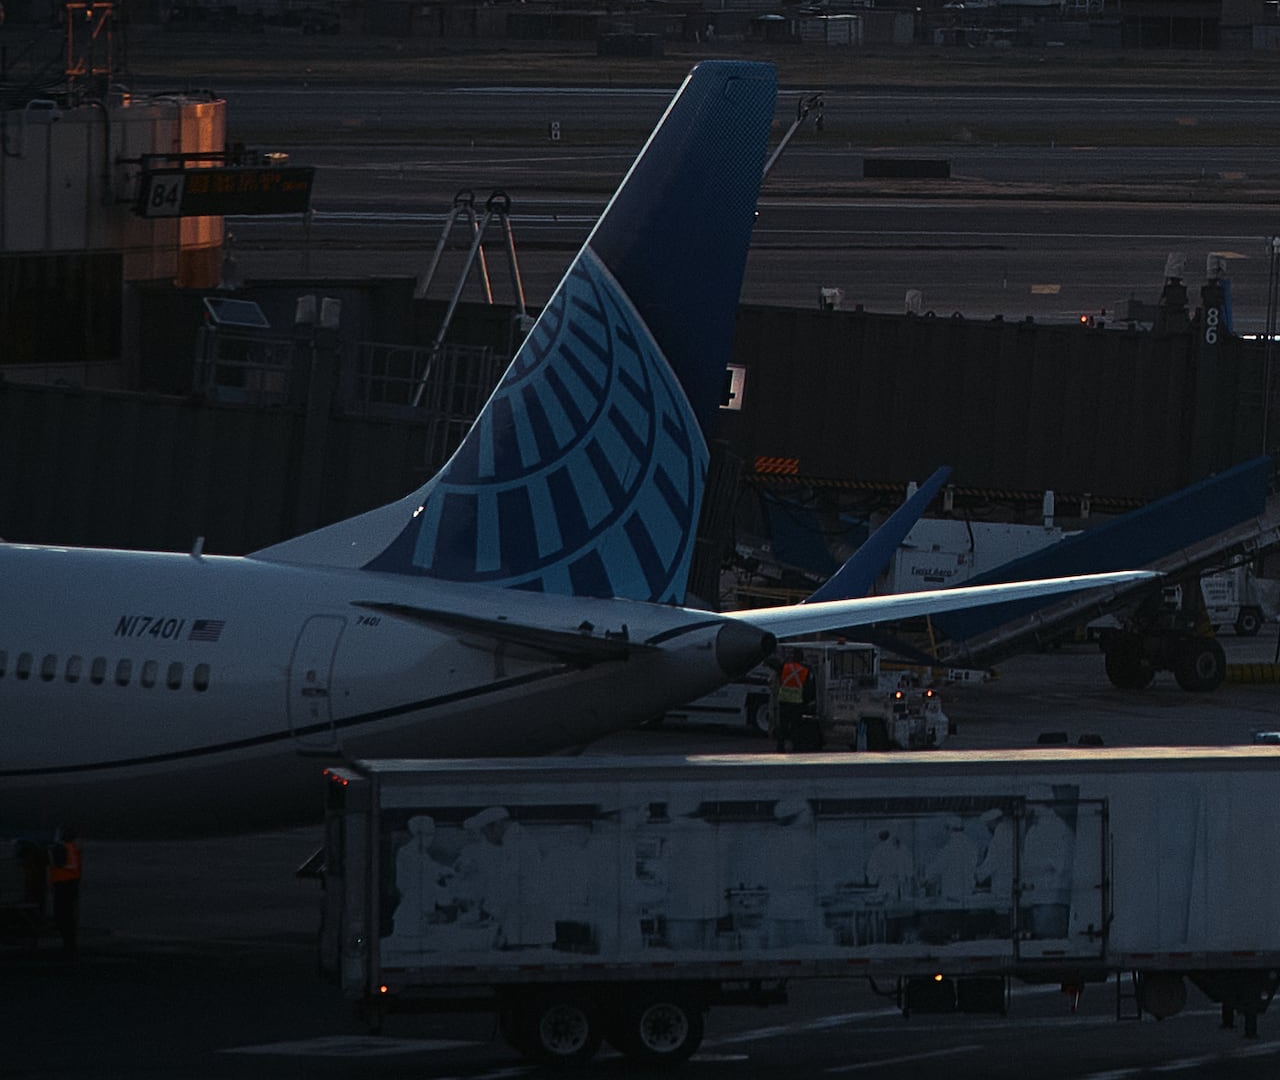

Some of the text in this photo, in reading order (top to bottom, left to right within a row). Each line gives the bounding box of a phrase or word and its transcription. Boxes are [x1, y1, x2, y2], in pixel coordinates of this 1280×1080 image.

[151, 183, 179, 207] 84
[1205, 307, 1219, 345] 86
[114, 614, 186, 641] N17401
[356, 616, 382, 627] 7401
